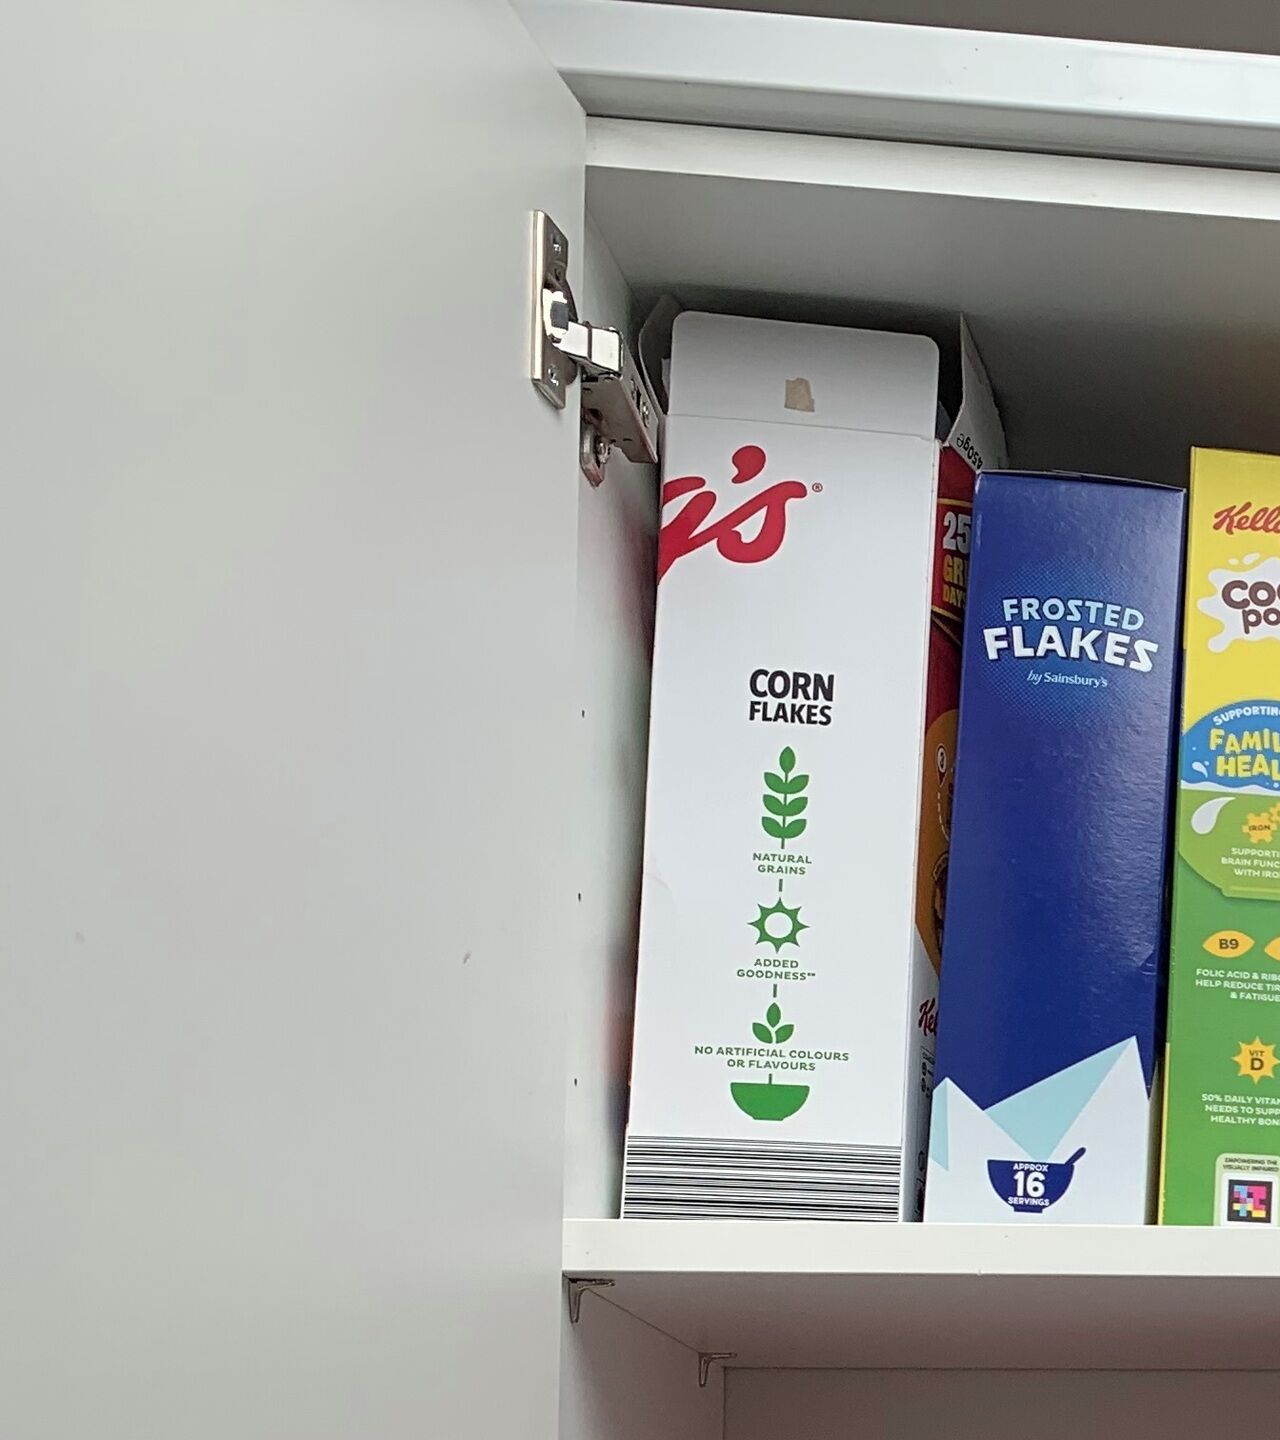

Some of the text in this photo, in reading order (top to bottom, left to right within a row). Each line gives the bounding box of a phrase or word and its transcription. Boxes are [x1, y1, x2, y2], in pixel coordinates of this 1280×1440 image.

[1002, 597, 1145, 631] FROSTED
[982, 625, 1159, 673] FLAKES
[1026, 669, 1108, 688] by Sainsbury's
[749, 669, 835, 702] CORN
[749, 701, 832, 726] FLAKES
[1248, 824, 1271, 832] IRON
[752, 852, 812, 864] NATURAL
[1221, 857, 1251, 866] BRAIN
[757, 864, 806, 875] GRAINS
[1234, 869, 1260, 877] WITH
[1219, 938, 1239, 950] B9
[754, 958, 799, 969] ADDED
[1196, 969, 1225, 978] FOLIC
[1227, 971, 1250, 979] ACID
[1195, 979, 1222, 988] HELP
[1223, 981, 1263, 991] REDUCE
[694, 1046, 849, 1061] NO ARTIFICIAL COLOURS
[727, 1059, 816, 1071] OR FLAVOURS
[1250, 1058, 1264, 1071] D
[1201, 1093, 1222, 1102] 50%
[1224, 1094, 1253, 1104] DAILY
[1205, 1104, 1239, 1114] NEEDS
[1241, 1106, 1254, 1114] TO
[1210, 1115, 1257, 1125] HEALTHY
[1013, 1162, 1049, 1172] APPROX
[1013, 1171, 1046, 1198] 16
[1007, 1196, 1050, 1207] SERVINGS
